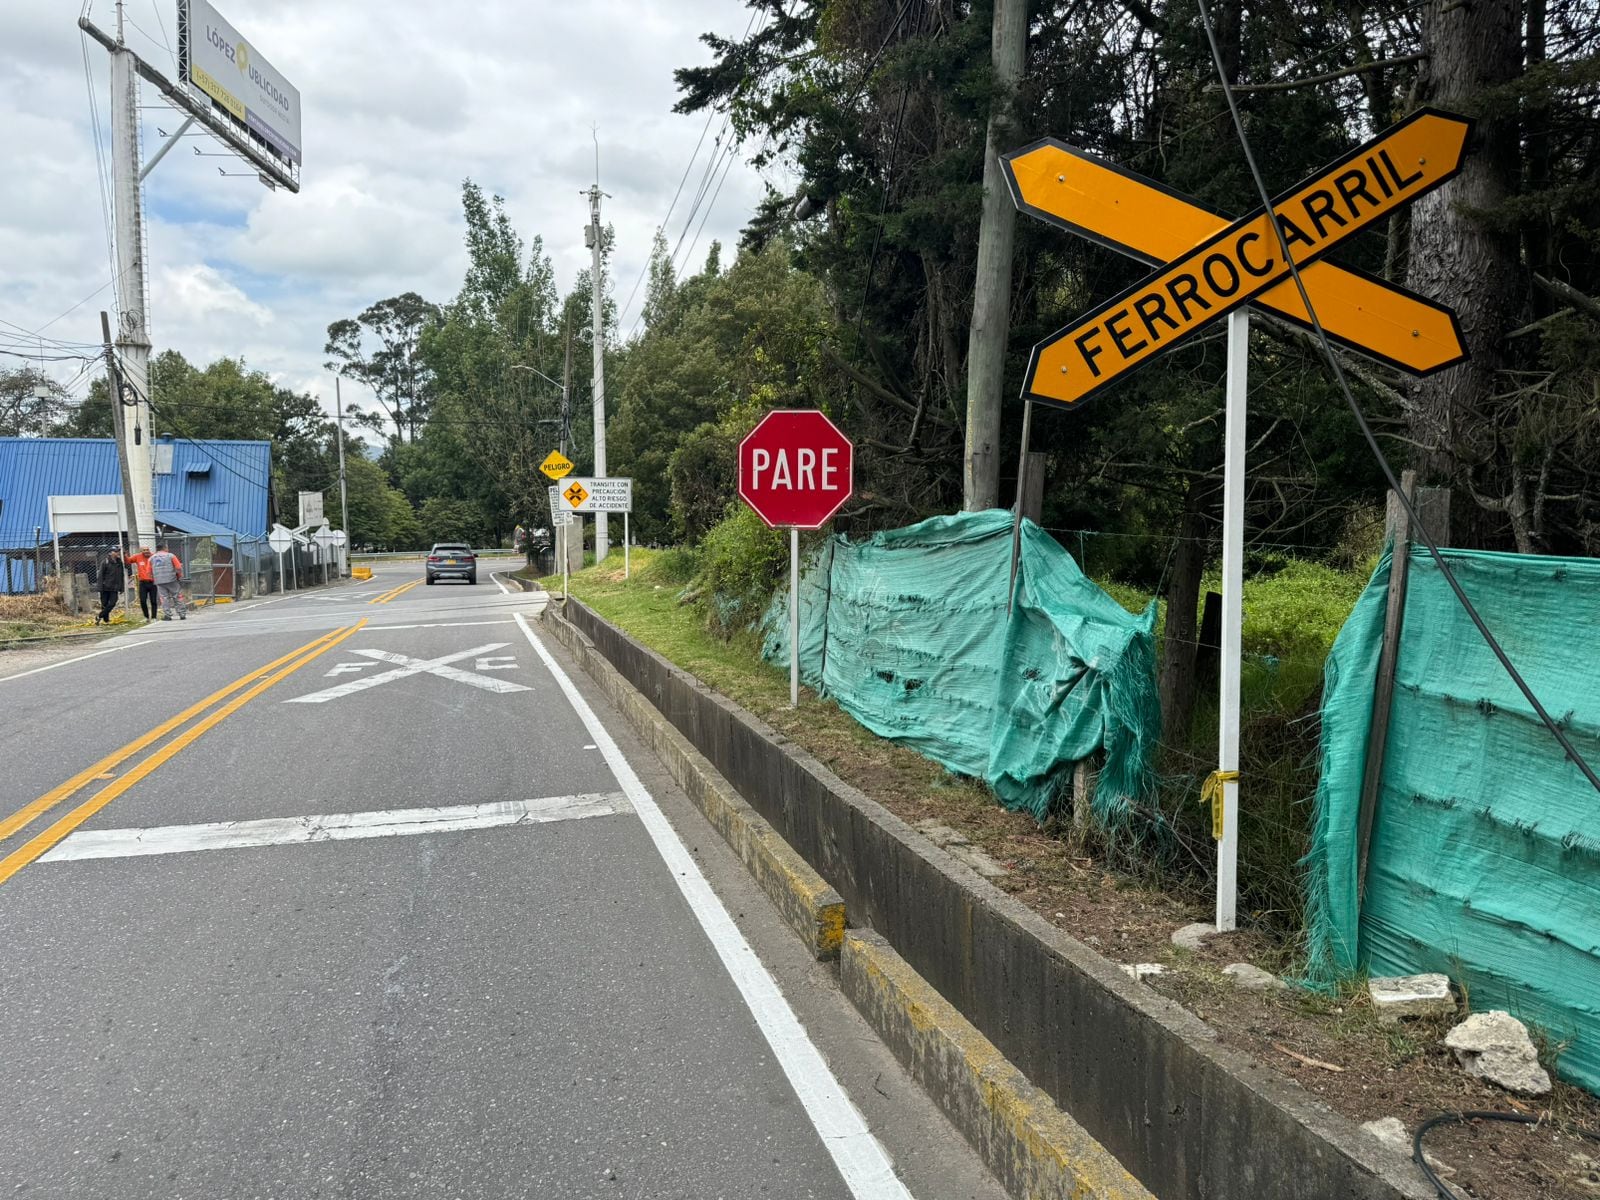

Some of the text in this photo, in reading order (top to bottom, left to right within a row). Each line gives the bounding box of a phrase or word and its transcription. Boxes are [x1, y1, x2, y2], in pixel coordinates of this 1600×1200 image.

[206, 25, 236, 64] LÓPEZ
[248, 64, 289, 111] UBLICIDAD
[1074, 149, 1424, 377] FERROCARRIL
[543, 462, 570, 472] PELIGRO
[752, 448, 839, 491] PARE
